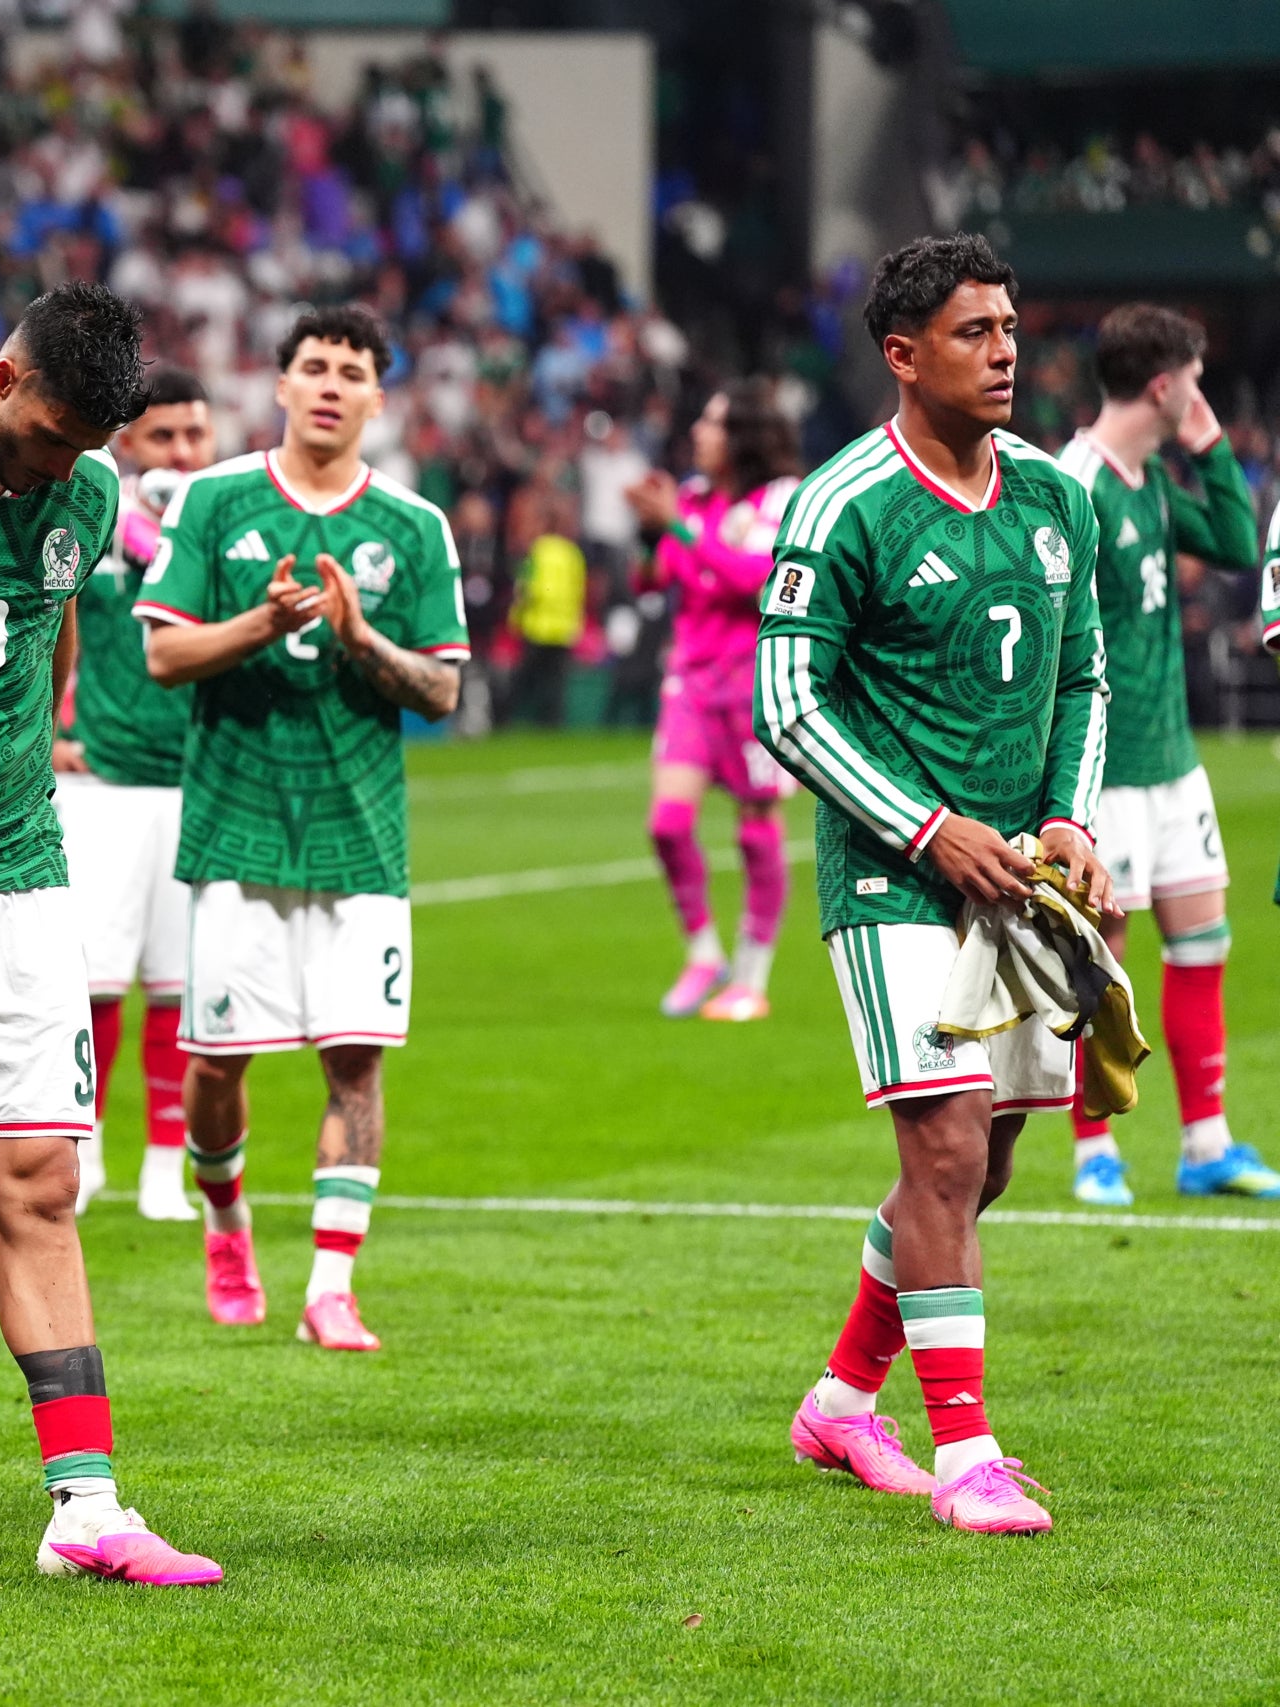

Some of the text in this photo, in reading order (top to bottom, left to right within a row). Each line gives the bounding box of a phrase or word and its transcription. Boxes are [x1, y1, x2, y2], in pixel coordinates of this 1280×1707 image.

[44, 576, 75, 588] MÉXICO
[988, 604, 1022, 682] 7
[384, 946, 402, 1006] 2
[74, 1028, 95, 1107] 9
